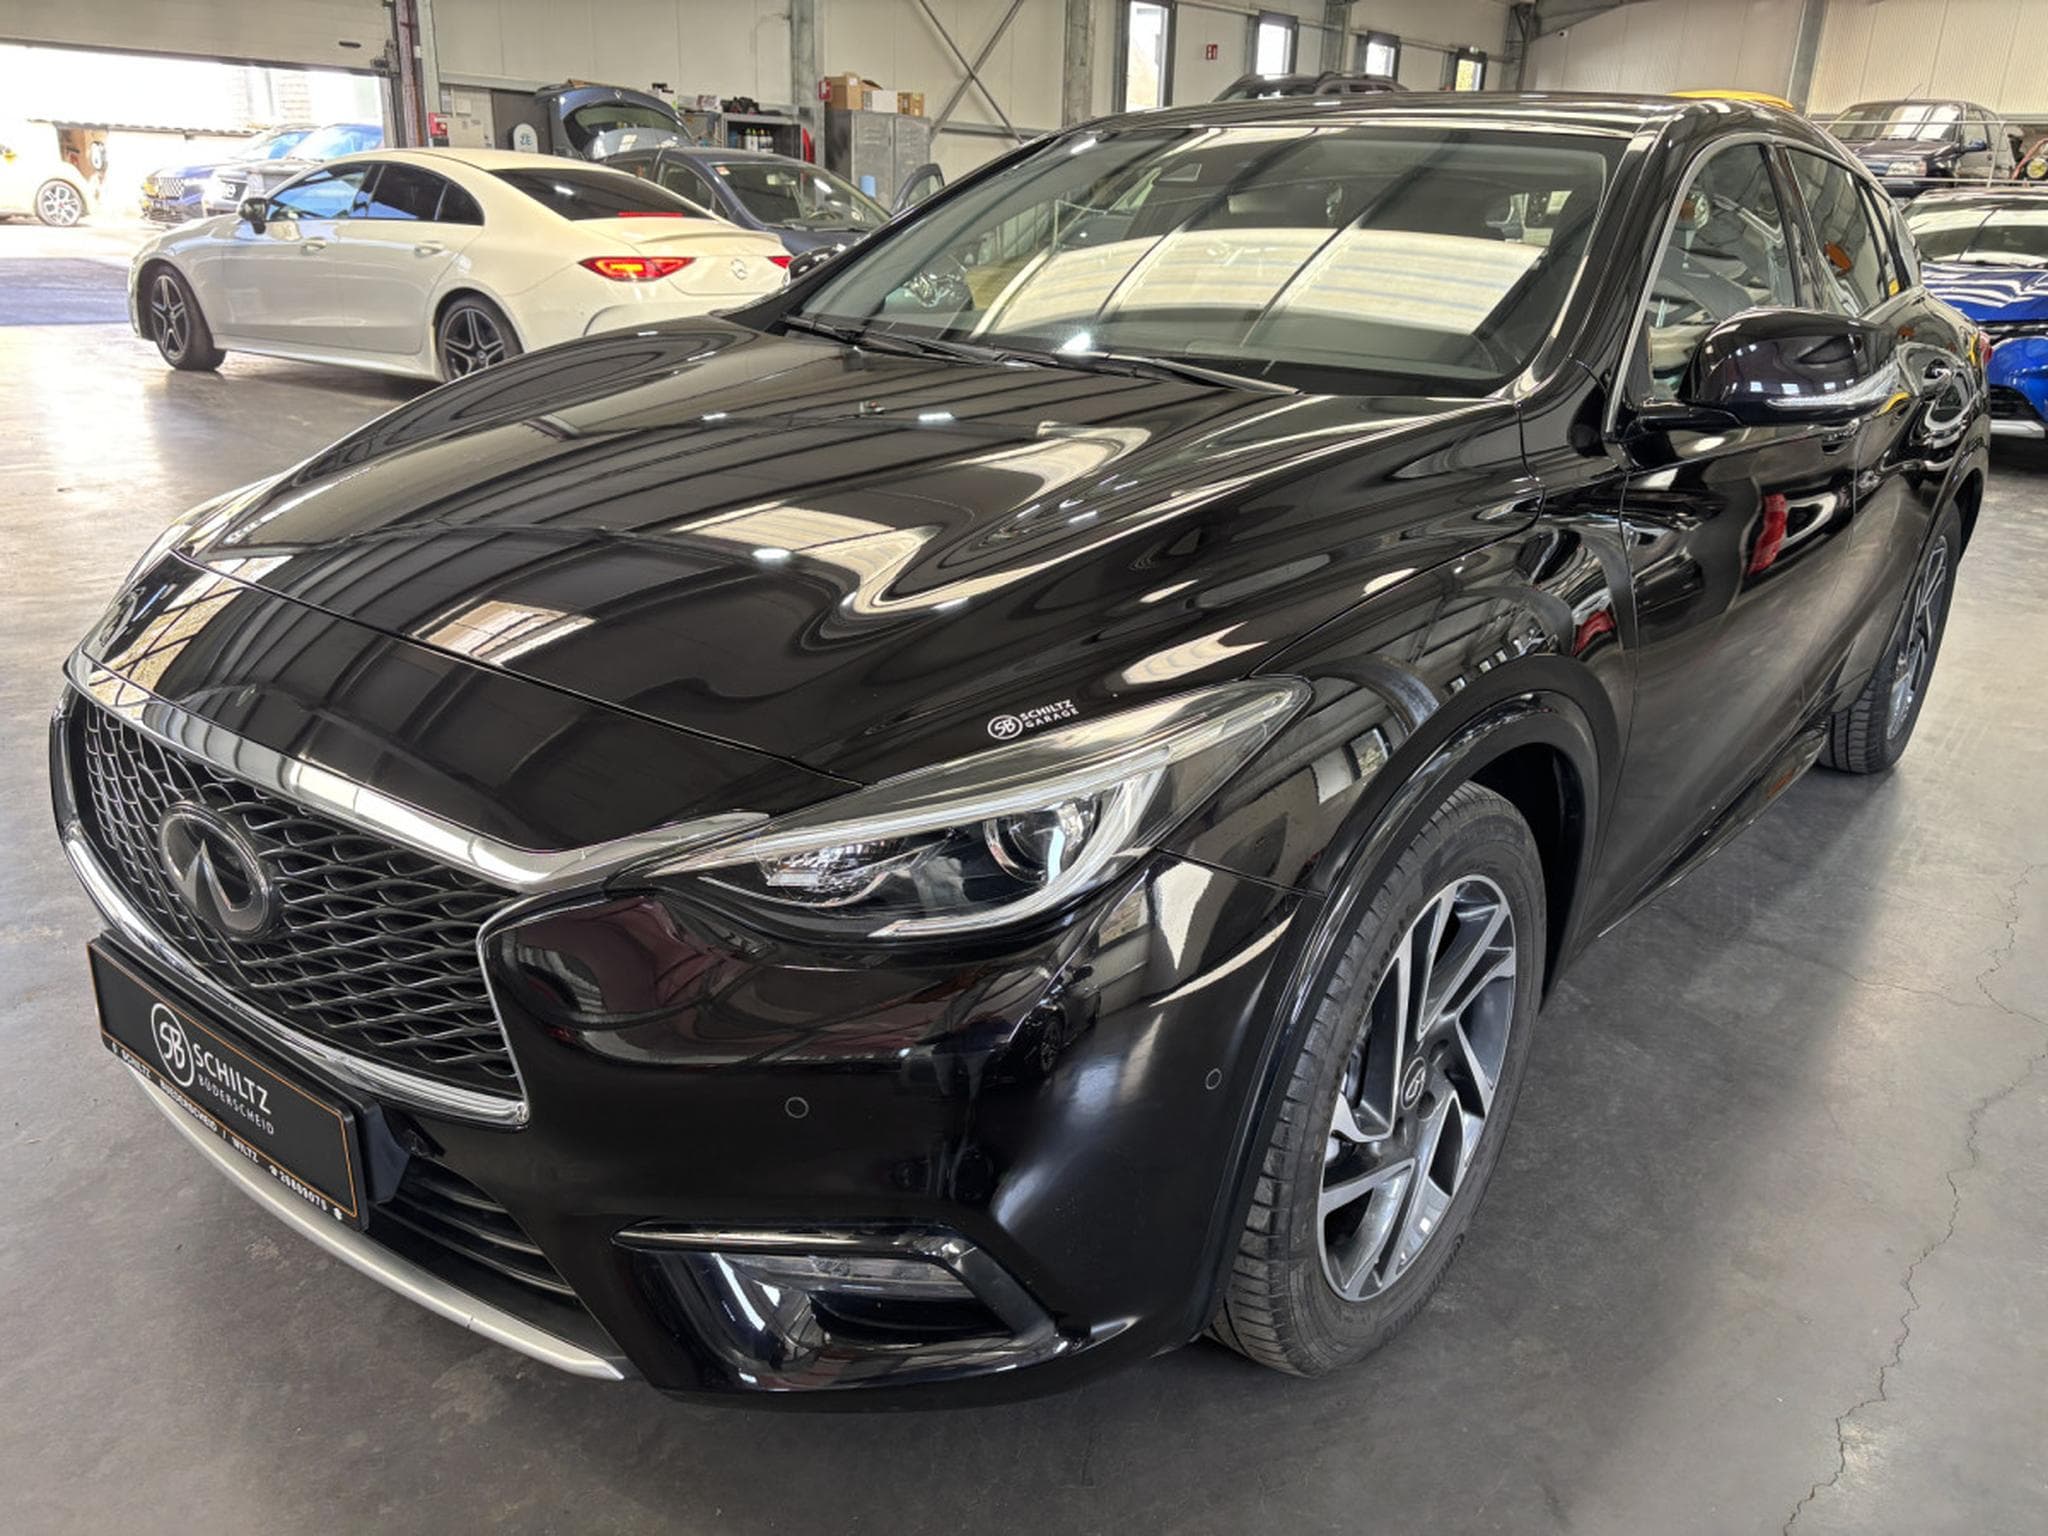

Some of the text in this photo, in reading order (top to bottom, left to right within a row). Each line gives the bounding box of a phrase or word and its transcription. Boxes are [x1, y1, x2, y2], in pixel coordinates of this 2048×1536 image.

[1019, 699, 1074, 721] SCHILTZ
[1024, 707, 1080, 728] GARAGE
[193, 1042, 272, 1115] SCHILTZ
[231, 1136, 260, 1164] WILTZ
